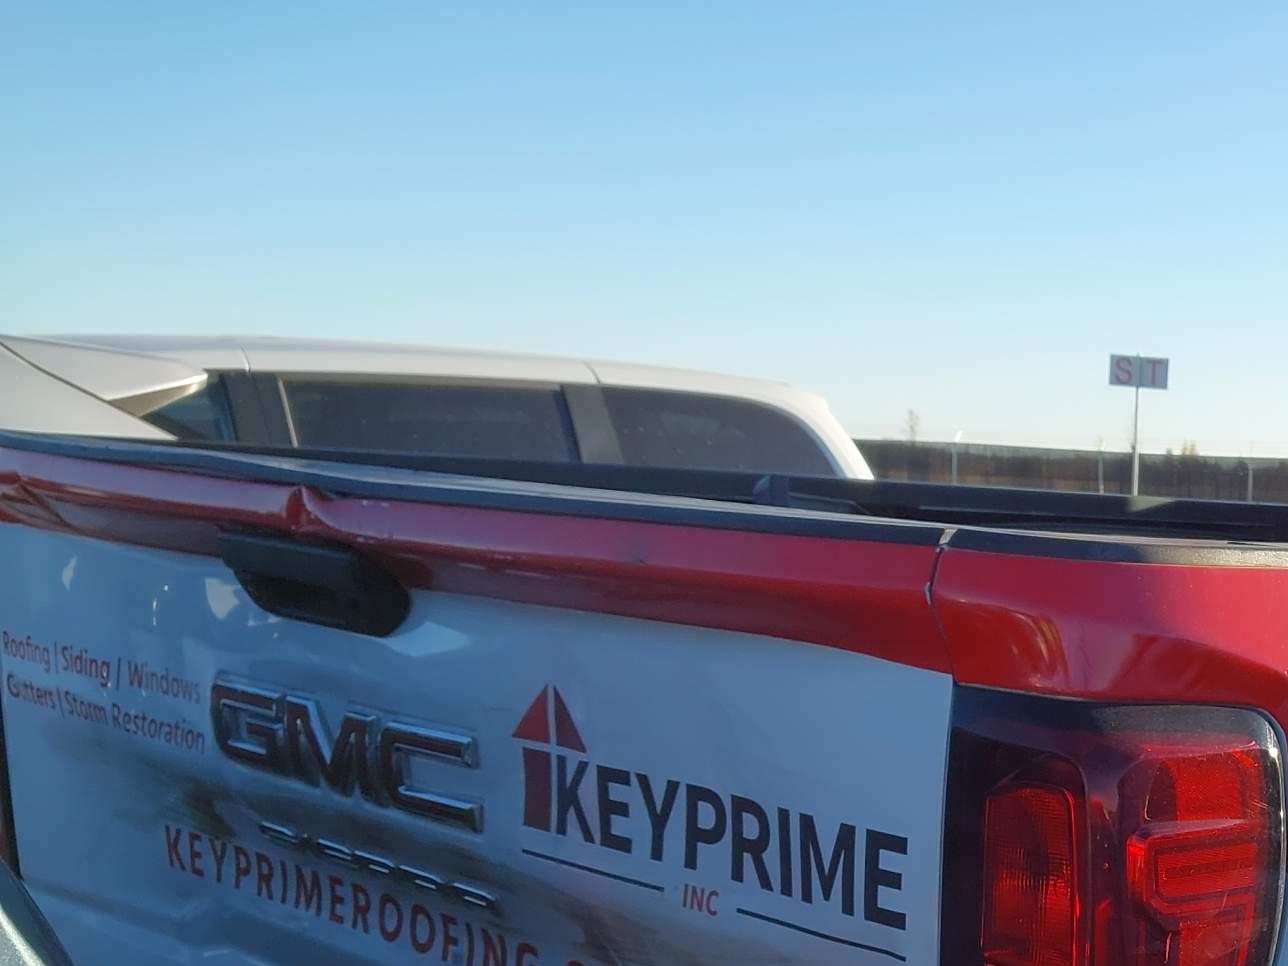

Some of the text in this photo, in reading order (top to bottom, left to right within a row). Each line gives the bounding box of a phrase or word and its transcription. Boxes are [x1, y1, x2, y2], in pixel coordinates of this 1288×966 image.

[3, 630, 50, 673] Roofing
[61, 646, 111, 688] Siding
[127, 658, 201, 704] Windows
[64, 689, 109, 727] Storm
[111, 702, 207, 755] Restoration
[210, 669, 485, 834] GMC
[555, 754, 908, 931] KEYPRIME
[682, 883, 720, 917] INC
